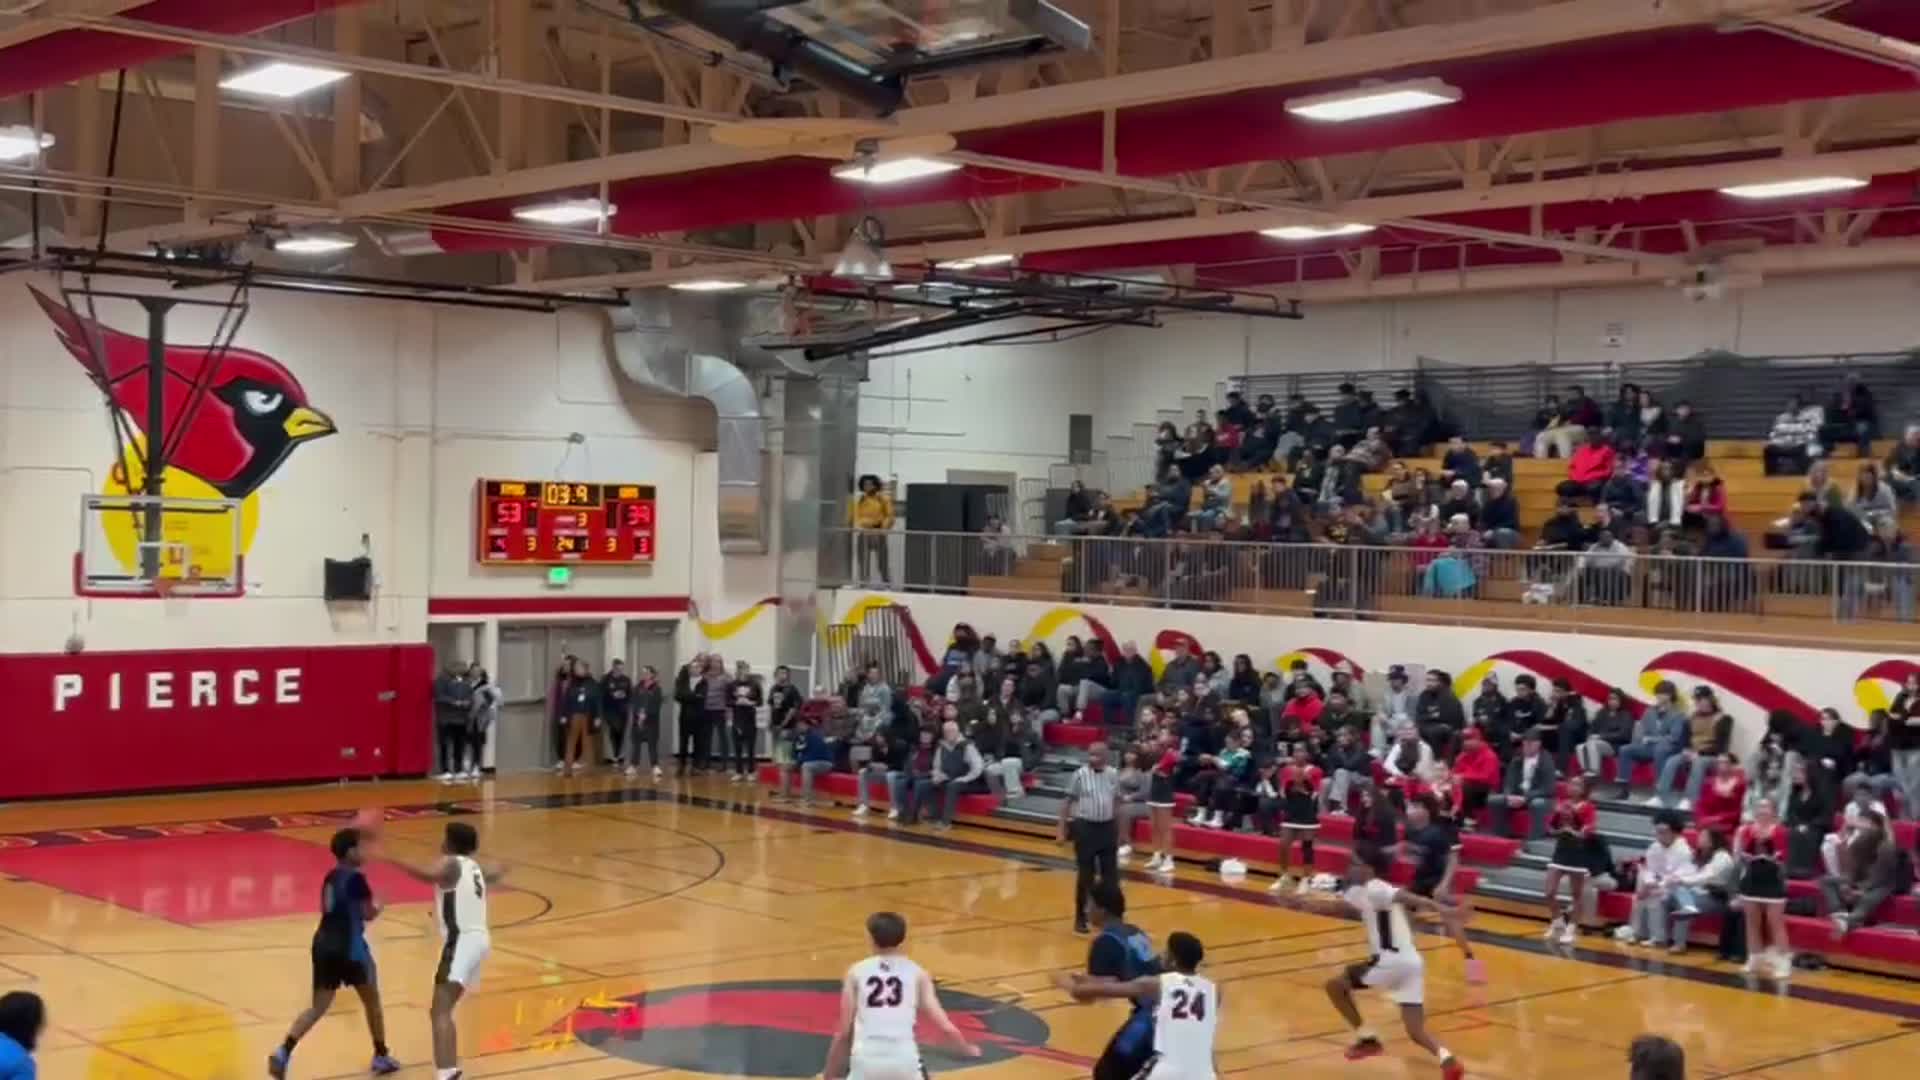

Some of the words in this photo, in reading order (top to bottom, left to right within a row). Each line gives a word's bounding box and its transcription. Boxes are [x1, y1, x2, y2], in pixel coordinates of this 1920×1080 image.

[497, 502, 522, 523] 53
[577, 512, 588, 527] 3
[527, 536, 537, 551] 3
[605, 537, 617, 552] 3
[53, 667, 303, 712] PIERCE
[865, 975, 904, 1008] 23
[1170, 989, 1207, 1021] 24
